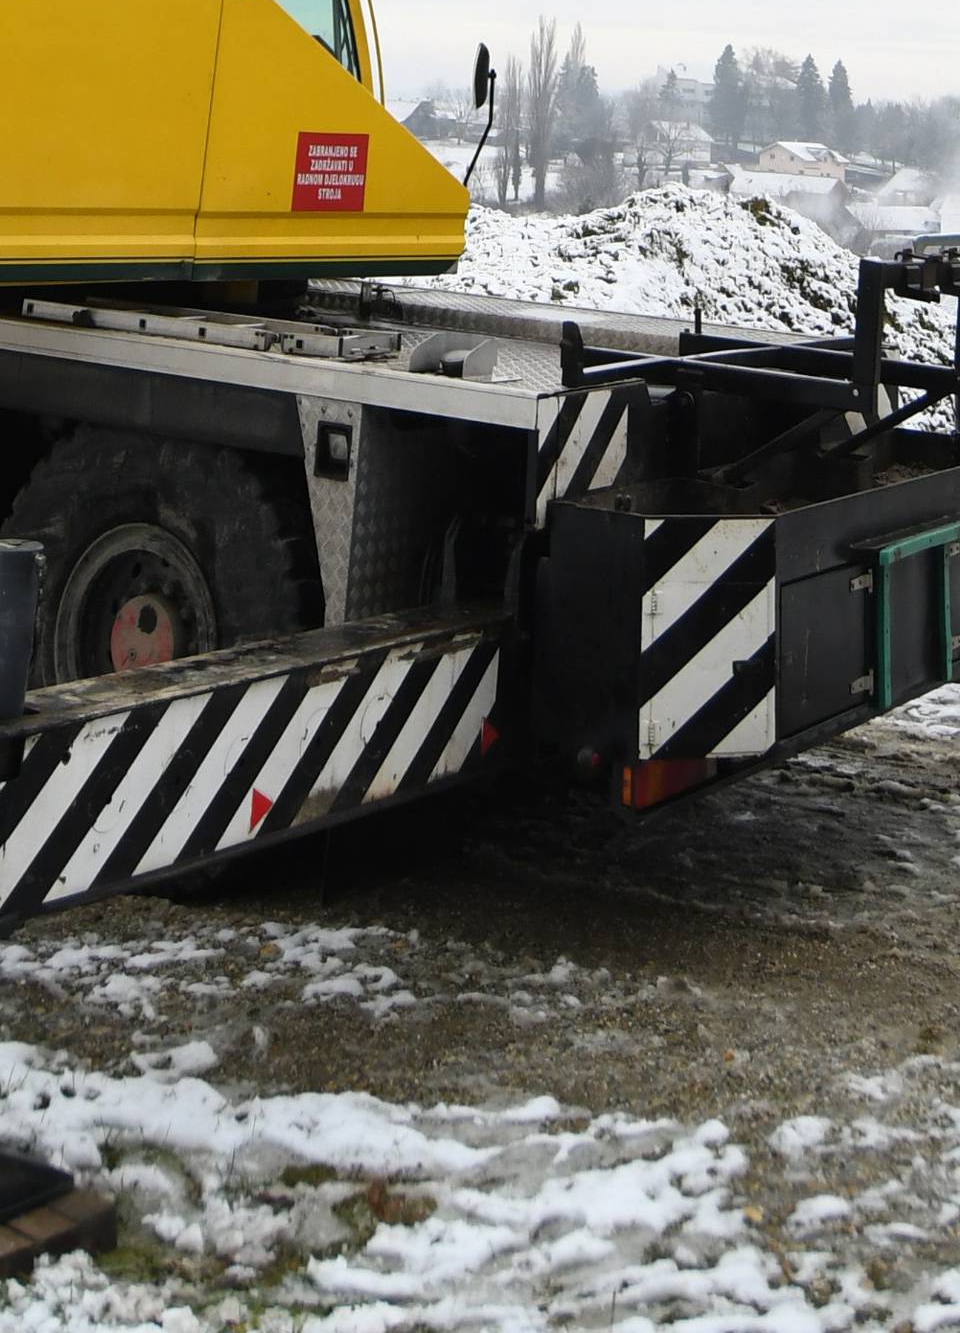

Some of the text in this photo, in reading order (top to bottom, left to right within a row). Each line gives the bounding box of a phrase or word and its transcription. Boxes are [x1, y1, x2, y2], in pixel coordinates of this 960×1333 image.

[308, 145, 358, 158] ZABRANJENO SE
[310, 158, 354, 171] ZADRŽAVATI U
[297, 173, 364, 186] RADNOM DJELOKRUGU
[318, 188, 341, 200] STROJA
